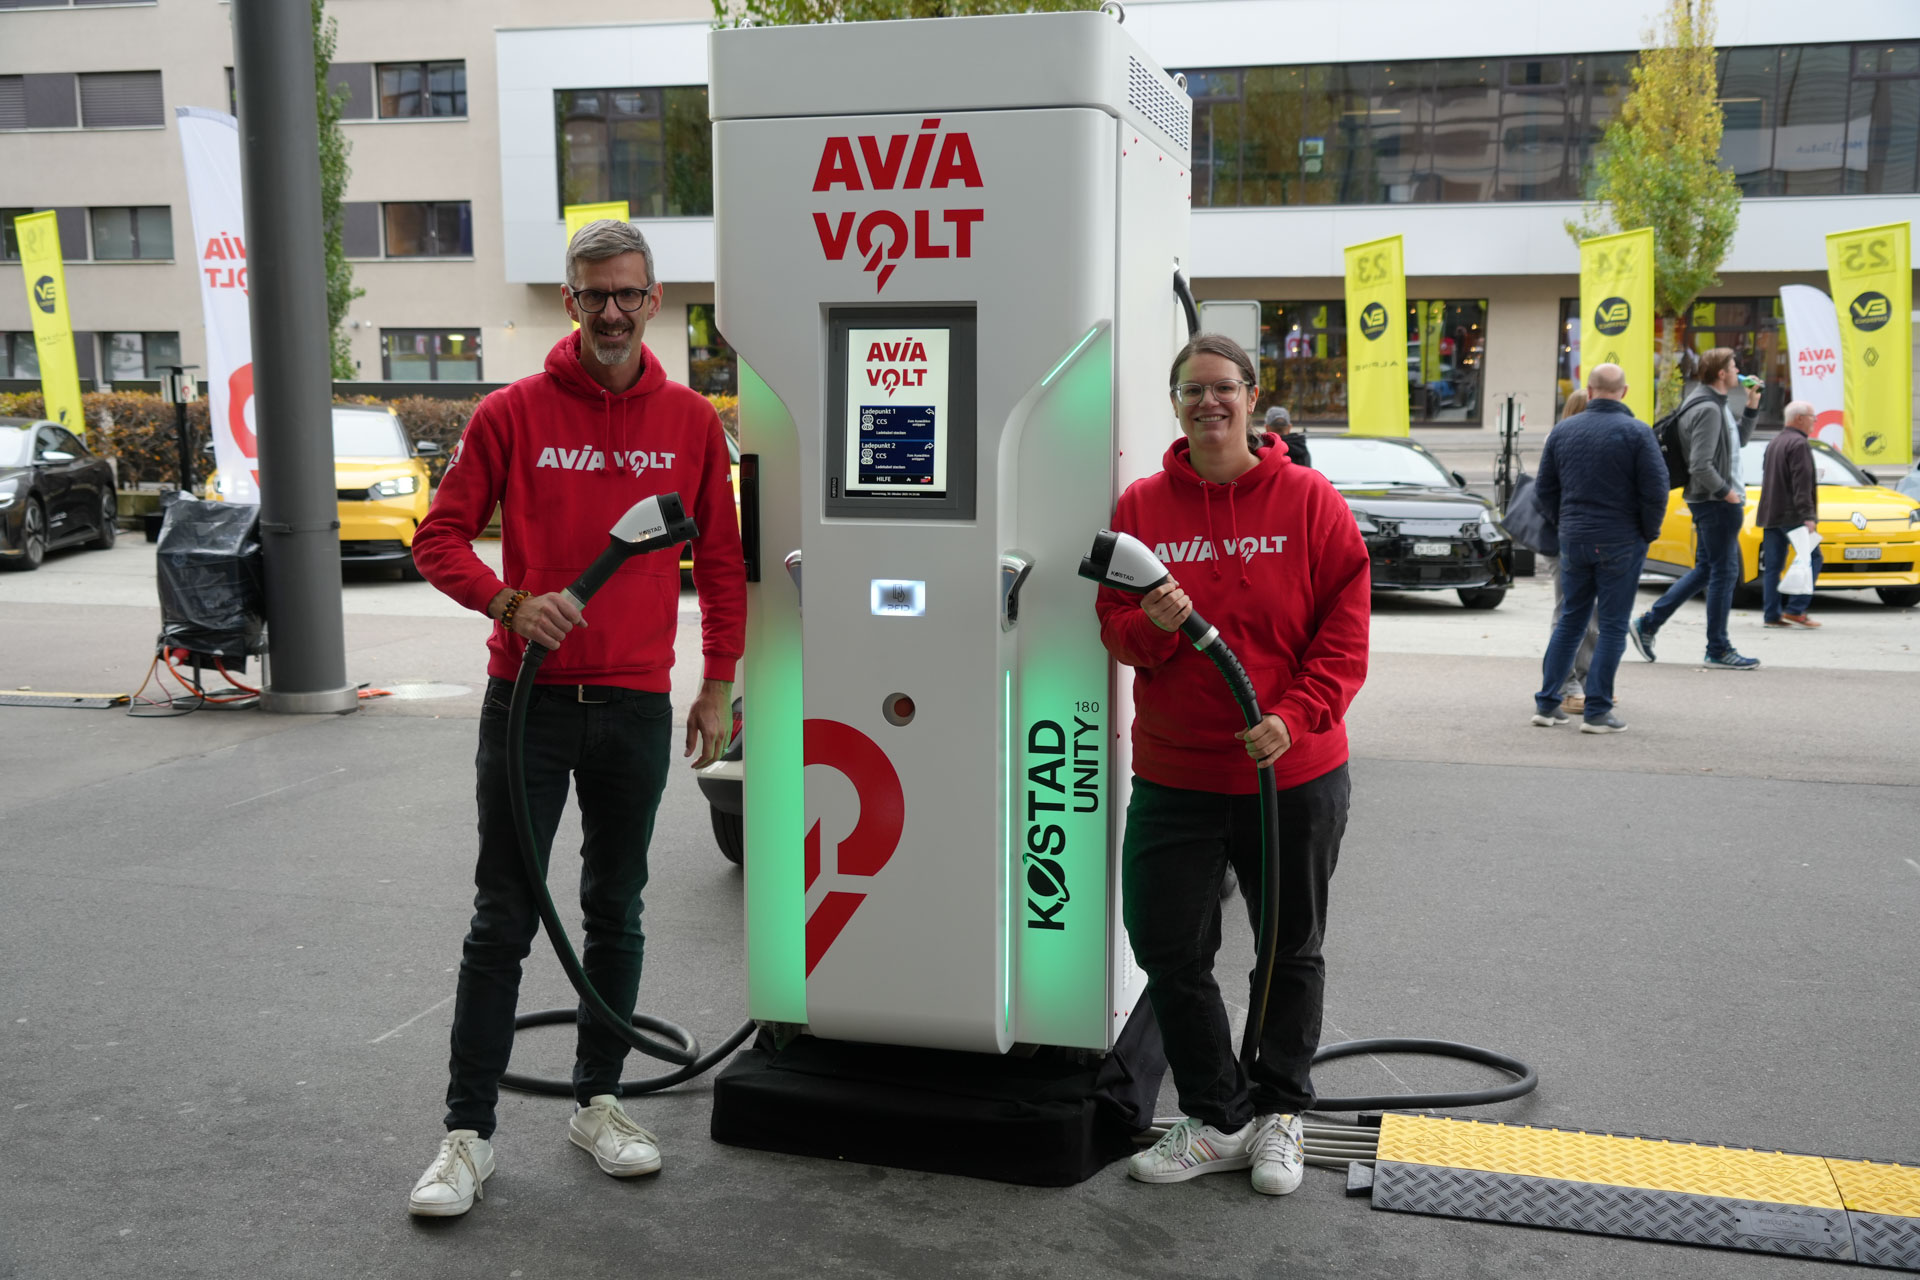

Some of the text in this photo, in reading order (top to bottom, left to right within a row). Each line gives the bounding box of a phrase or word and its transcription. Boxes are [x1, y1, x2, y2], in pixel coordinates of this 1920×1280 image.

[812, 118, 984, 192] AVIA
[812, 208, 984, 295] VOLT
[866, 337, 928, 362] AVIA
[866, 368, 928, 399] VOLT
[537, 445, 676, 478] AVIA VOLT
[1153, 535, 1287, 564] AVIA VOLT
[1111, 571, 1134, 581] KOSTAD
[1075, 701, 1099, 713] 180
[1073, 715, 1099, 813] UNITY
